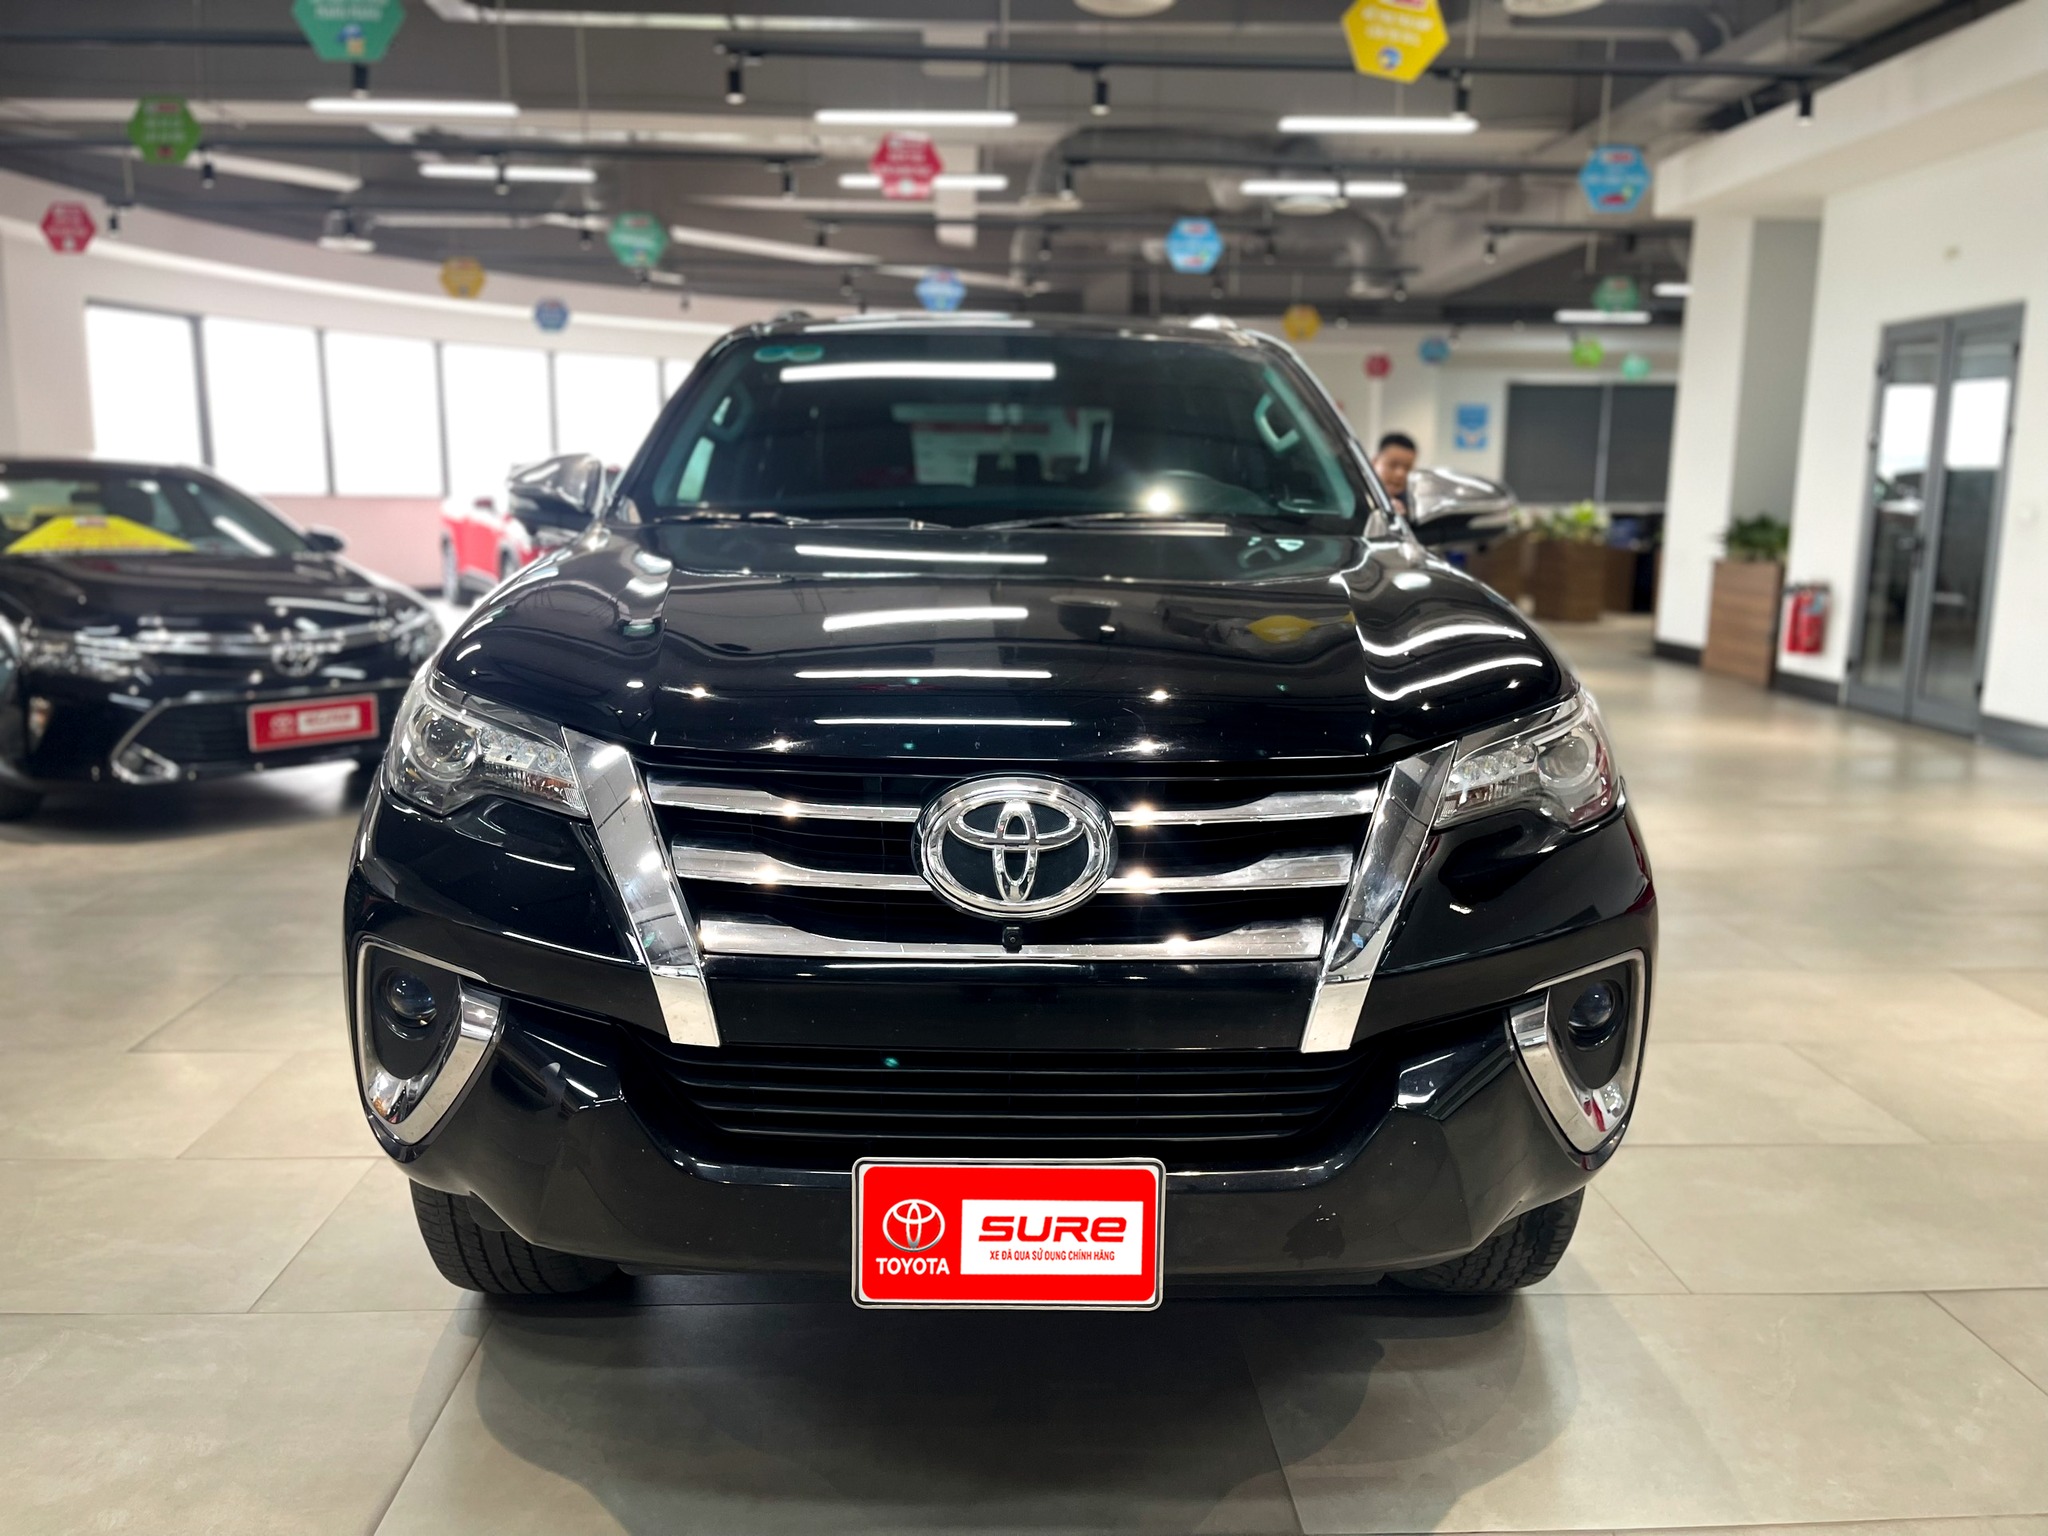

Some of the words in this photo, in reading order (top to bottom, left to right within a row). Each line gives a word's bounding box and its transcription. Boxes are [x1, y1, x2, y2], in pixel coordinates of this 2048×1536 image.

[989, 1250, 1000, 1260] XE
[1014, 1250, 1030, 1261] QUA
[1068, 1248, 1091, 1260] CHÍNH
[876, 1258, 950, 1275] TOYOTA
